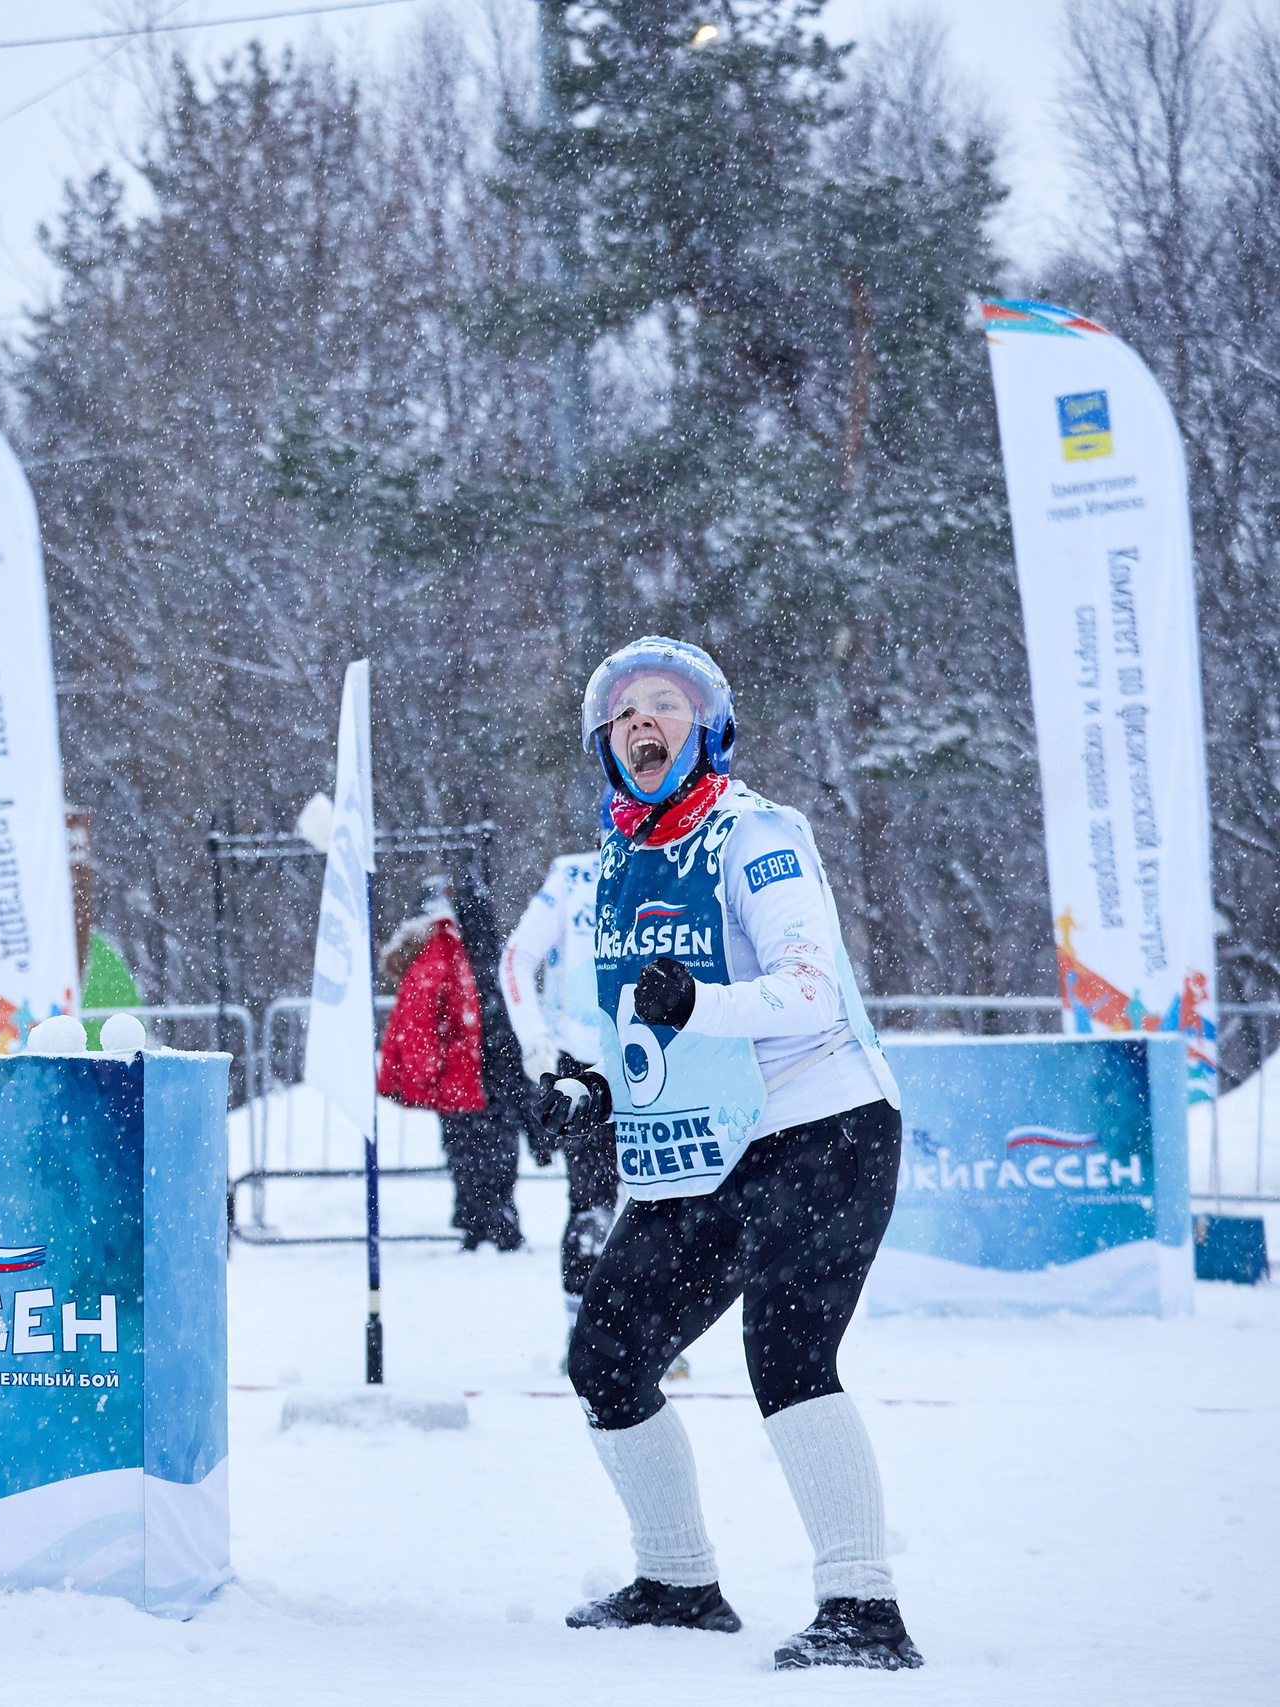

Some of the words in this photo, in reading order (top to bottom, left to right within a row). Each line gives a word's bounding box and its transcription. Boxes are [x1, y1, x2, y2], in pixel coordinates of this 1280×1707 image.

[749, 853, 796, 887] СЕВЕР
[637, 1116, 715, 1144] ТОЛК
[621, 1141, 724, 1176] СНЕГЕ
[78, 1369, 120, 1388] БОЙ
